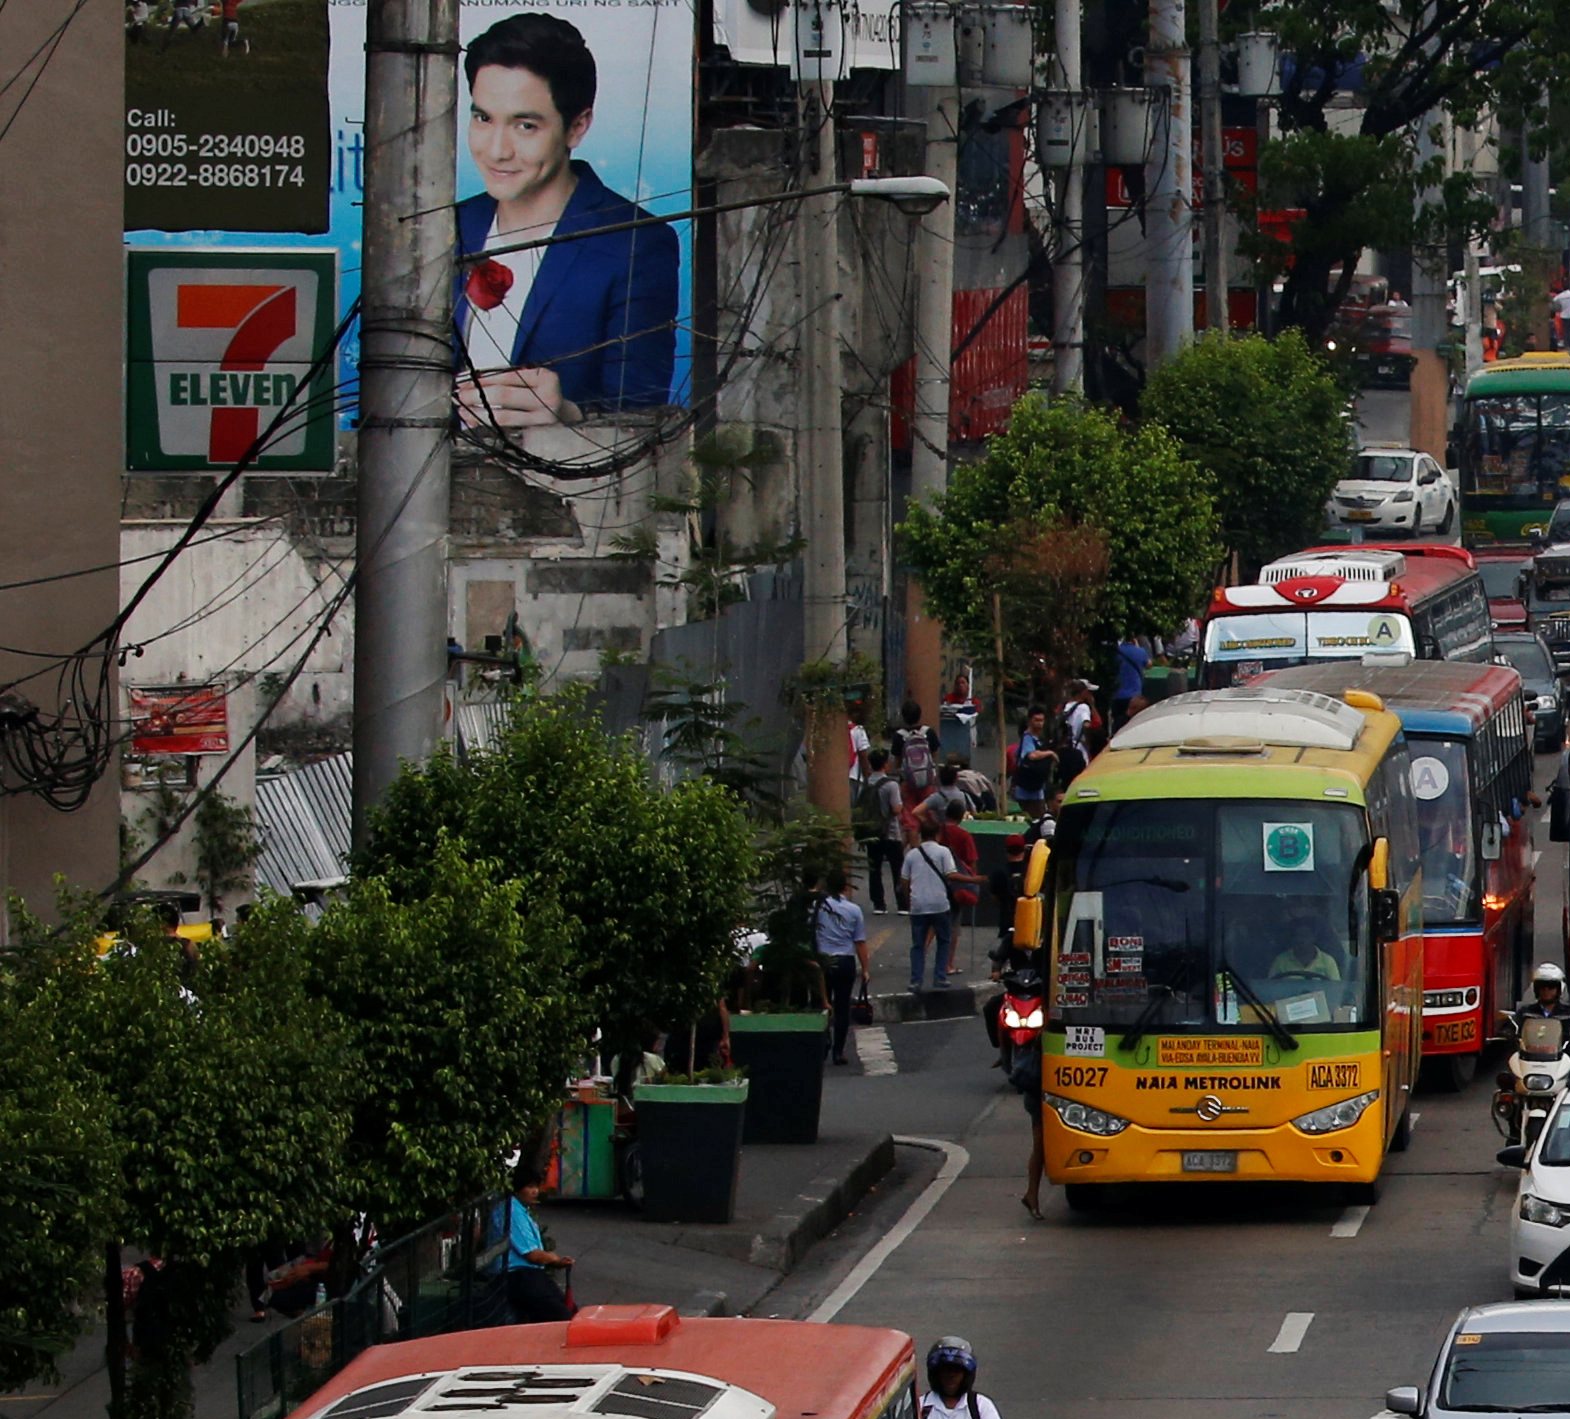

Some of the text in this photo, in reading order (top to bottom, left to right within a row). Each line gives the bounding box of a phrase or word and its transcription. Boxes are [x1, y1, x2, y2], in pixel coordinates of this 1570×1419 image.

[126, 108, 177, 128] Call:
[126, 134, 305, 159] 0905-2340948
[126, 163, 305, 187] 0922-8868174
[176, 284, 297, 464] 7
[1375, 622, 1393, 639] A
[1415, 766, 1438, 790] A
[1279, 835, 1300, 858] B
[1065, 1043, 1104, 1051] PROJECT
[1053, 1067, 1109, 1087] 15027
[1136, 1076, 1282, 1090] NAIA METROLINK
